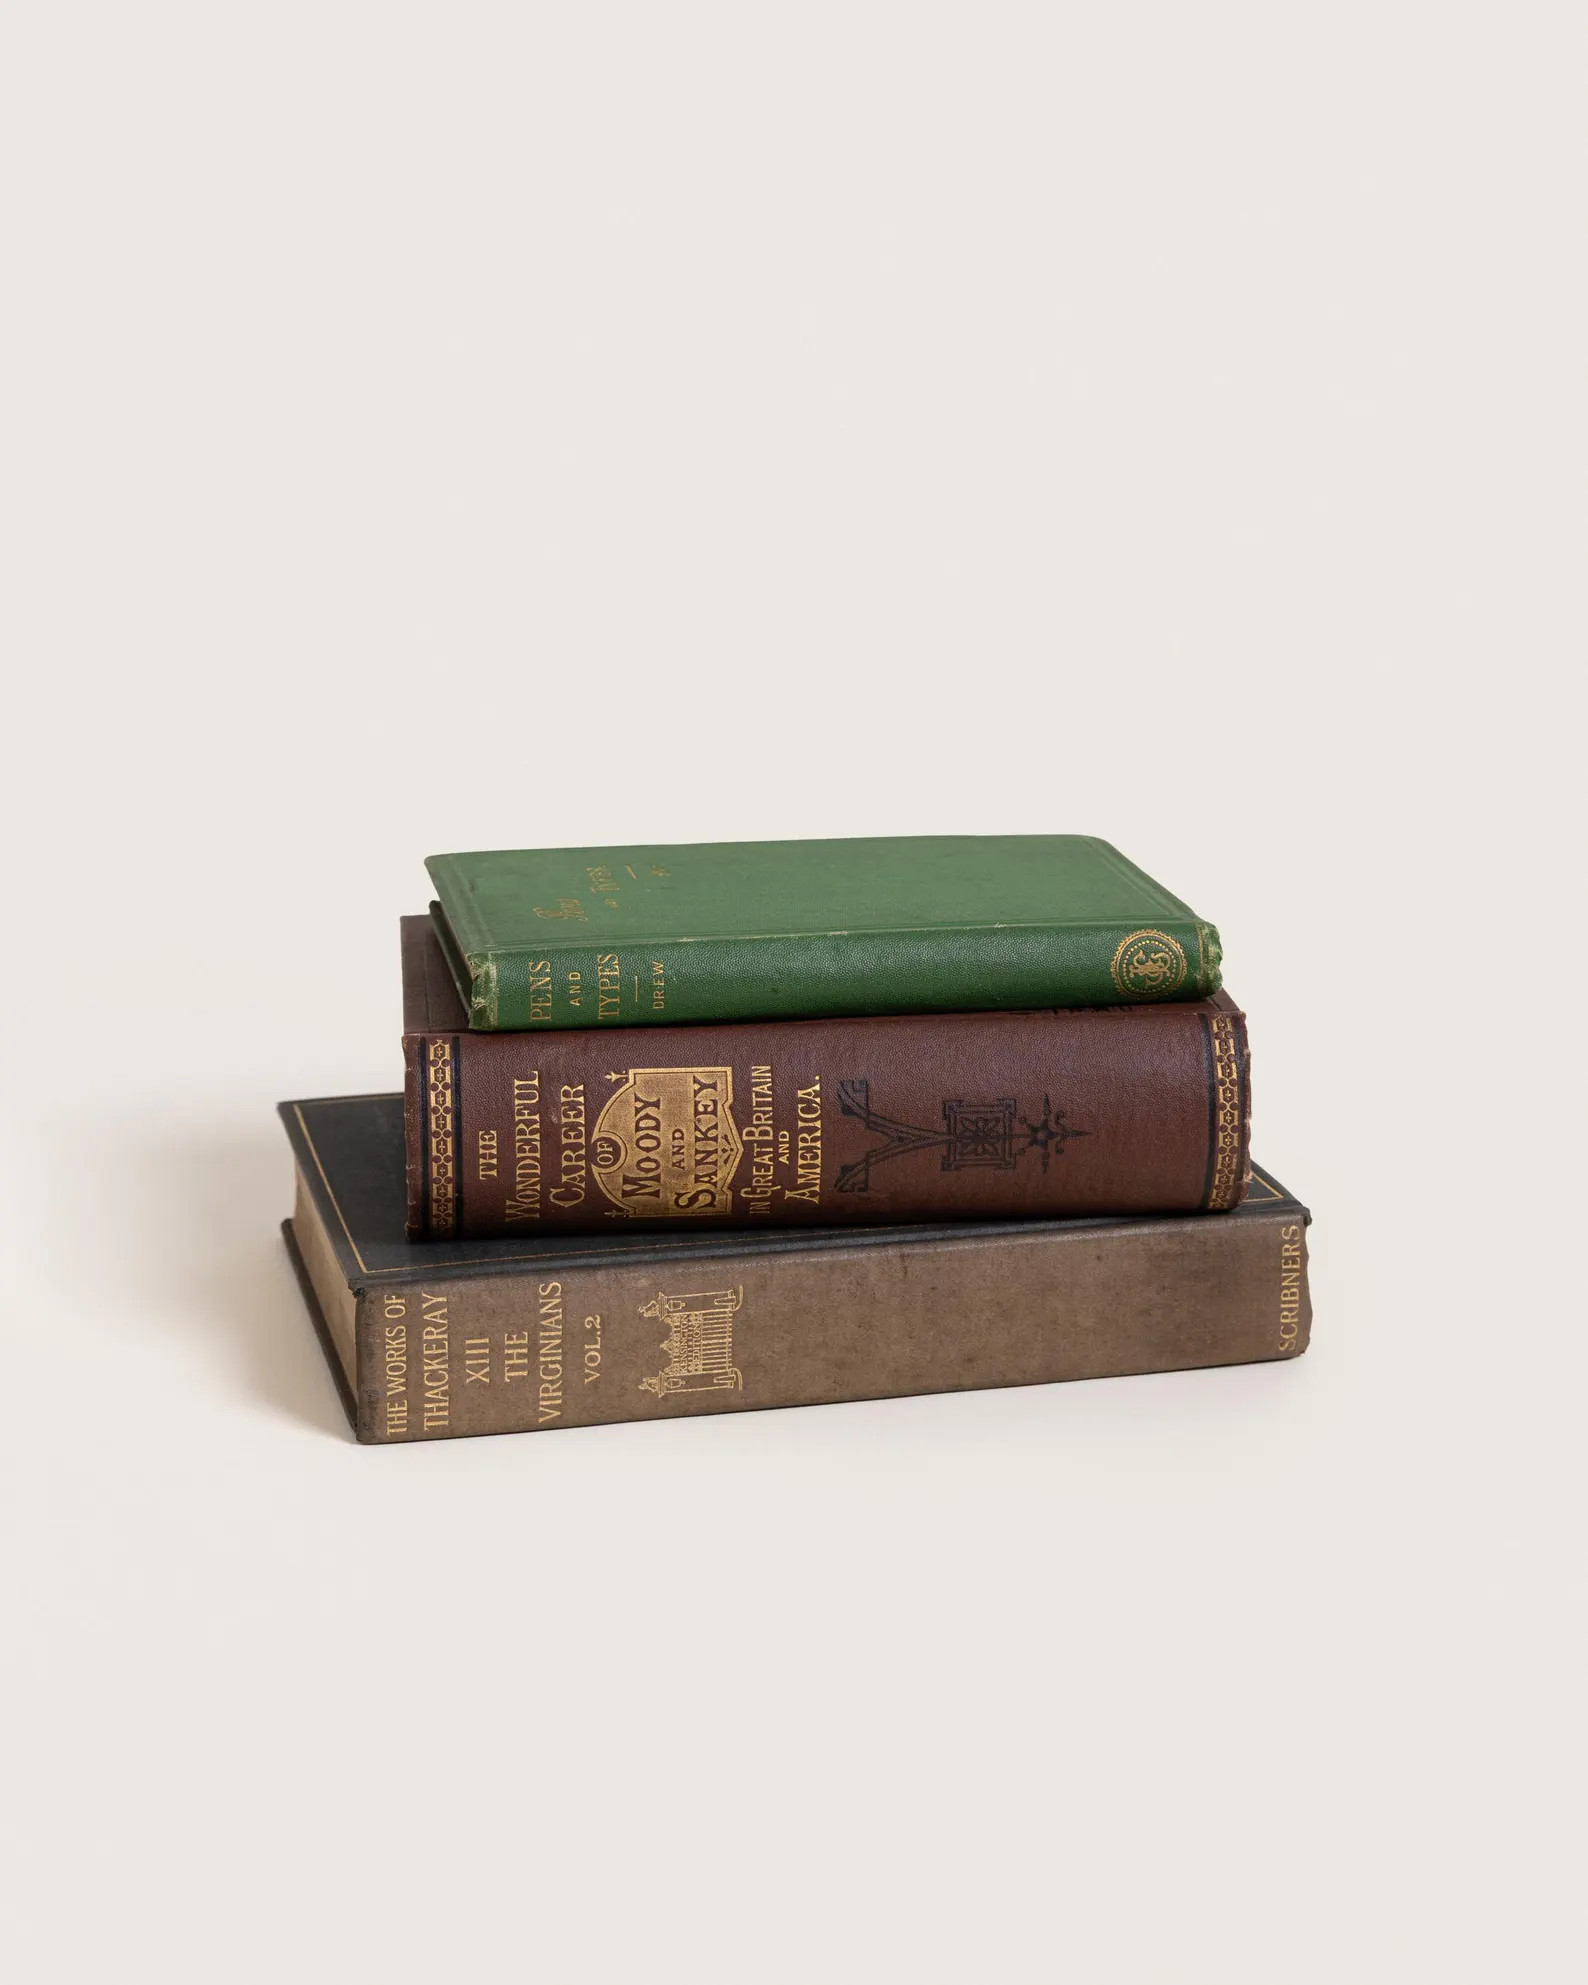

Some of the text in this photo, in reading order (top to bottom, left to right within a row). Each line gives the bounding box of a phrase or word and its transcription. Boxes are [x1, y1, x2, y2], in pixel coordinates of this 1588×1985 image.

[528, 959, 552, 1022] PENS
[568, 971, 581, 1006] AND
[597, 953, 620, 1020] TYPES
[652, 960, 664, 1010] DREW
[478, 1130, 498, 1180] THE
[505, 1070, 541, 1223] WONDERFUL
[550, 1084, 586, 1208] CAREER
[597, 1140, 614, 1167] OF
[621, 1091, 661, 1199] MOODY
[672, 1128, 686, 1171] AND
[674, 1074, 718, 1209] SANKEY
[740, 1065, 781, 1215] IN GREAT BRITAIN
[778, 1130, 790, 1165] AND
[785, 1075, 822, 1205] AMERICA.
[1279, 1224, 1301, 1352] SCRIBNERS
[384, 1294, 408, 1438] THE WORKS OF
[421, 1291, 449, 1432] THACKERAY
[465, 1337, 490, 1384] XIII
[504, 1331, 529, 1383] THE
[538, 1281, 563, 1424] VIRGINIANS
